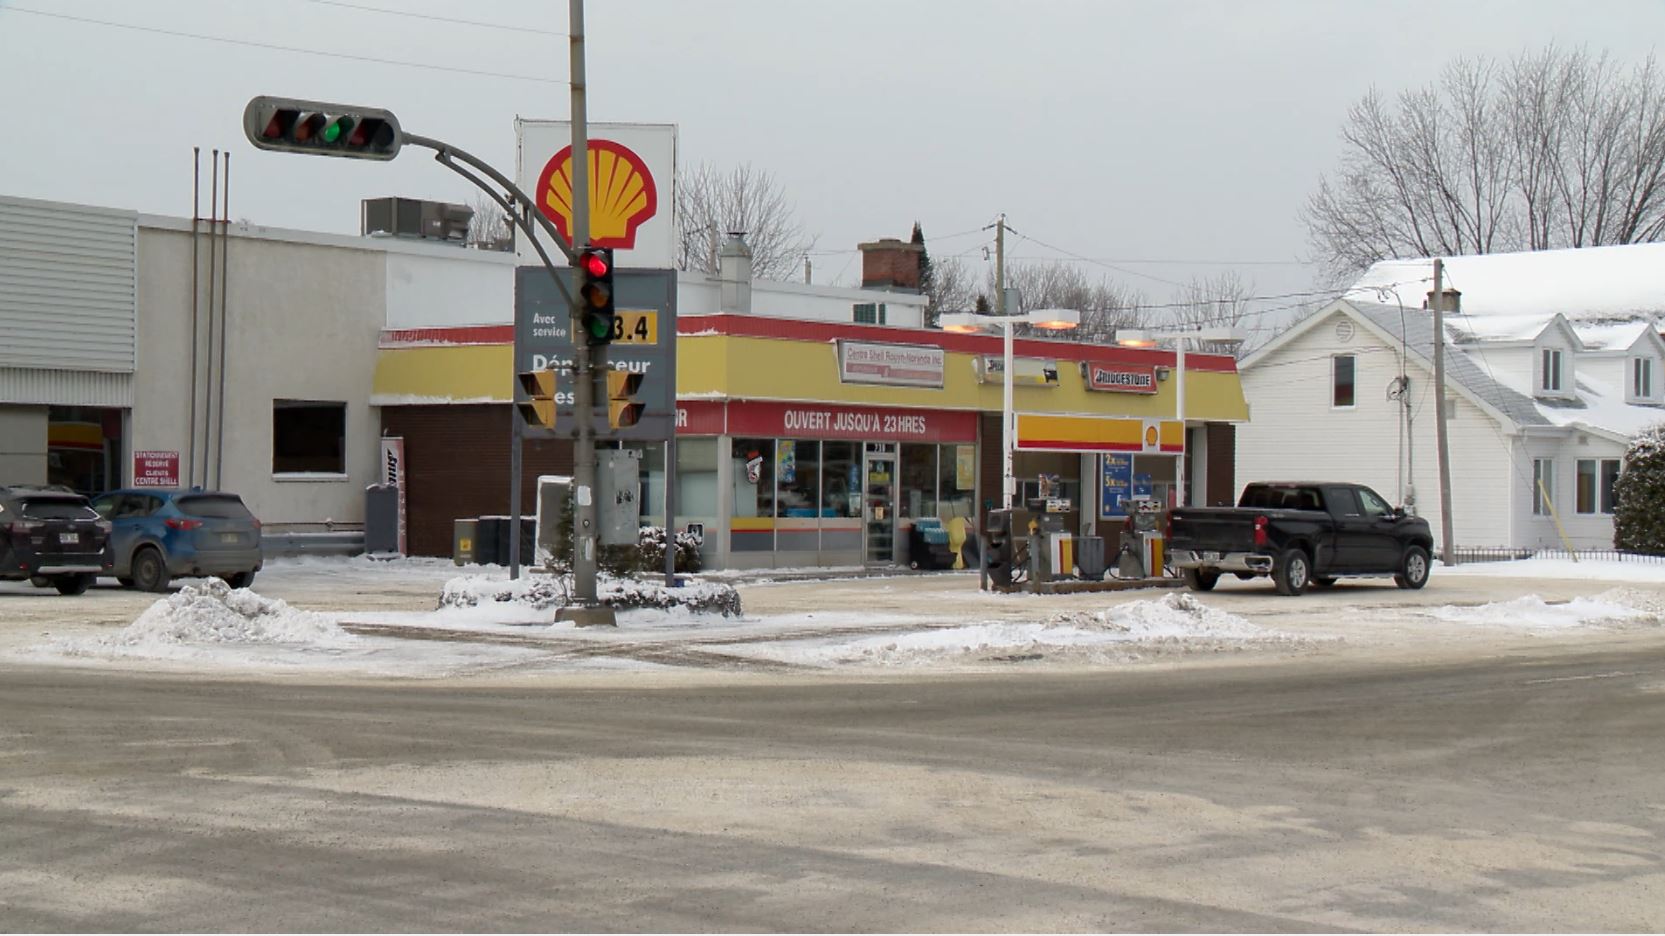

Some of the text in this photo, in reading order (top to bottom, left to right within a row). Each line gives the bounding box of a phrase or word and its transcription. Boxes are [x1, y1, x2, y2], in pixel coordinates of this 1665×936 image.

[533, 313, 556, 324] Avec
[533, 326, 566, 338] service
[613, 316, 648, 340] 3.4
[1096, 371, 1150, 385] BRIDGESTONE
[784, 410, 831, 430] OUVERT
[833, 411, 880, 432] JUSQU'À
[135, 477, 177, 485] CENTRE SHELL
